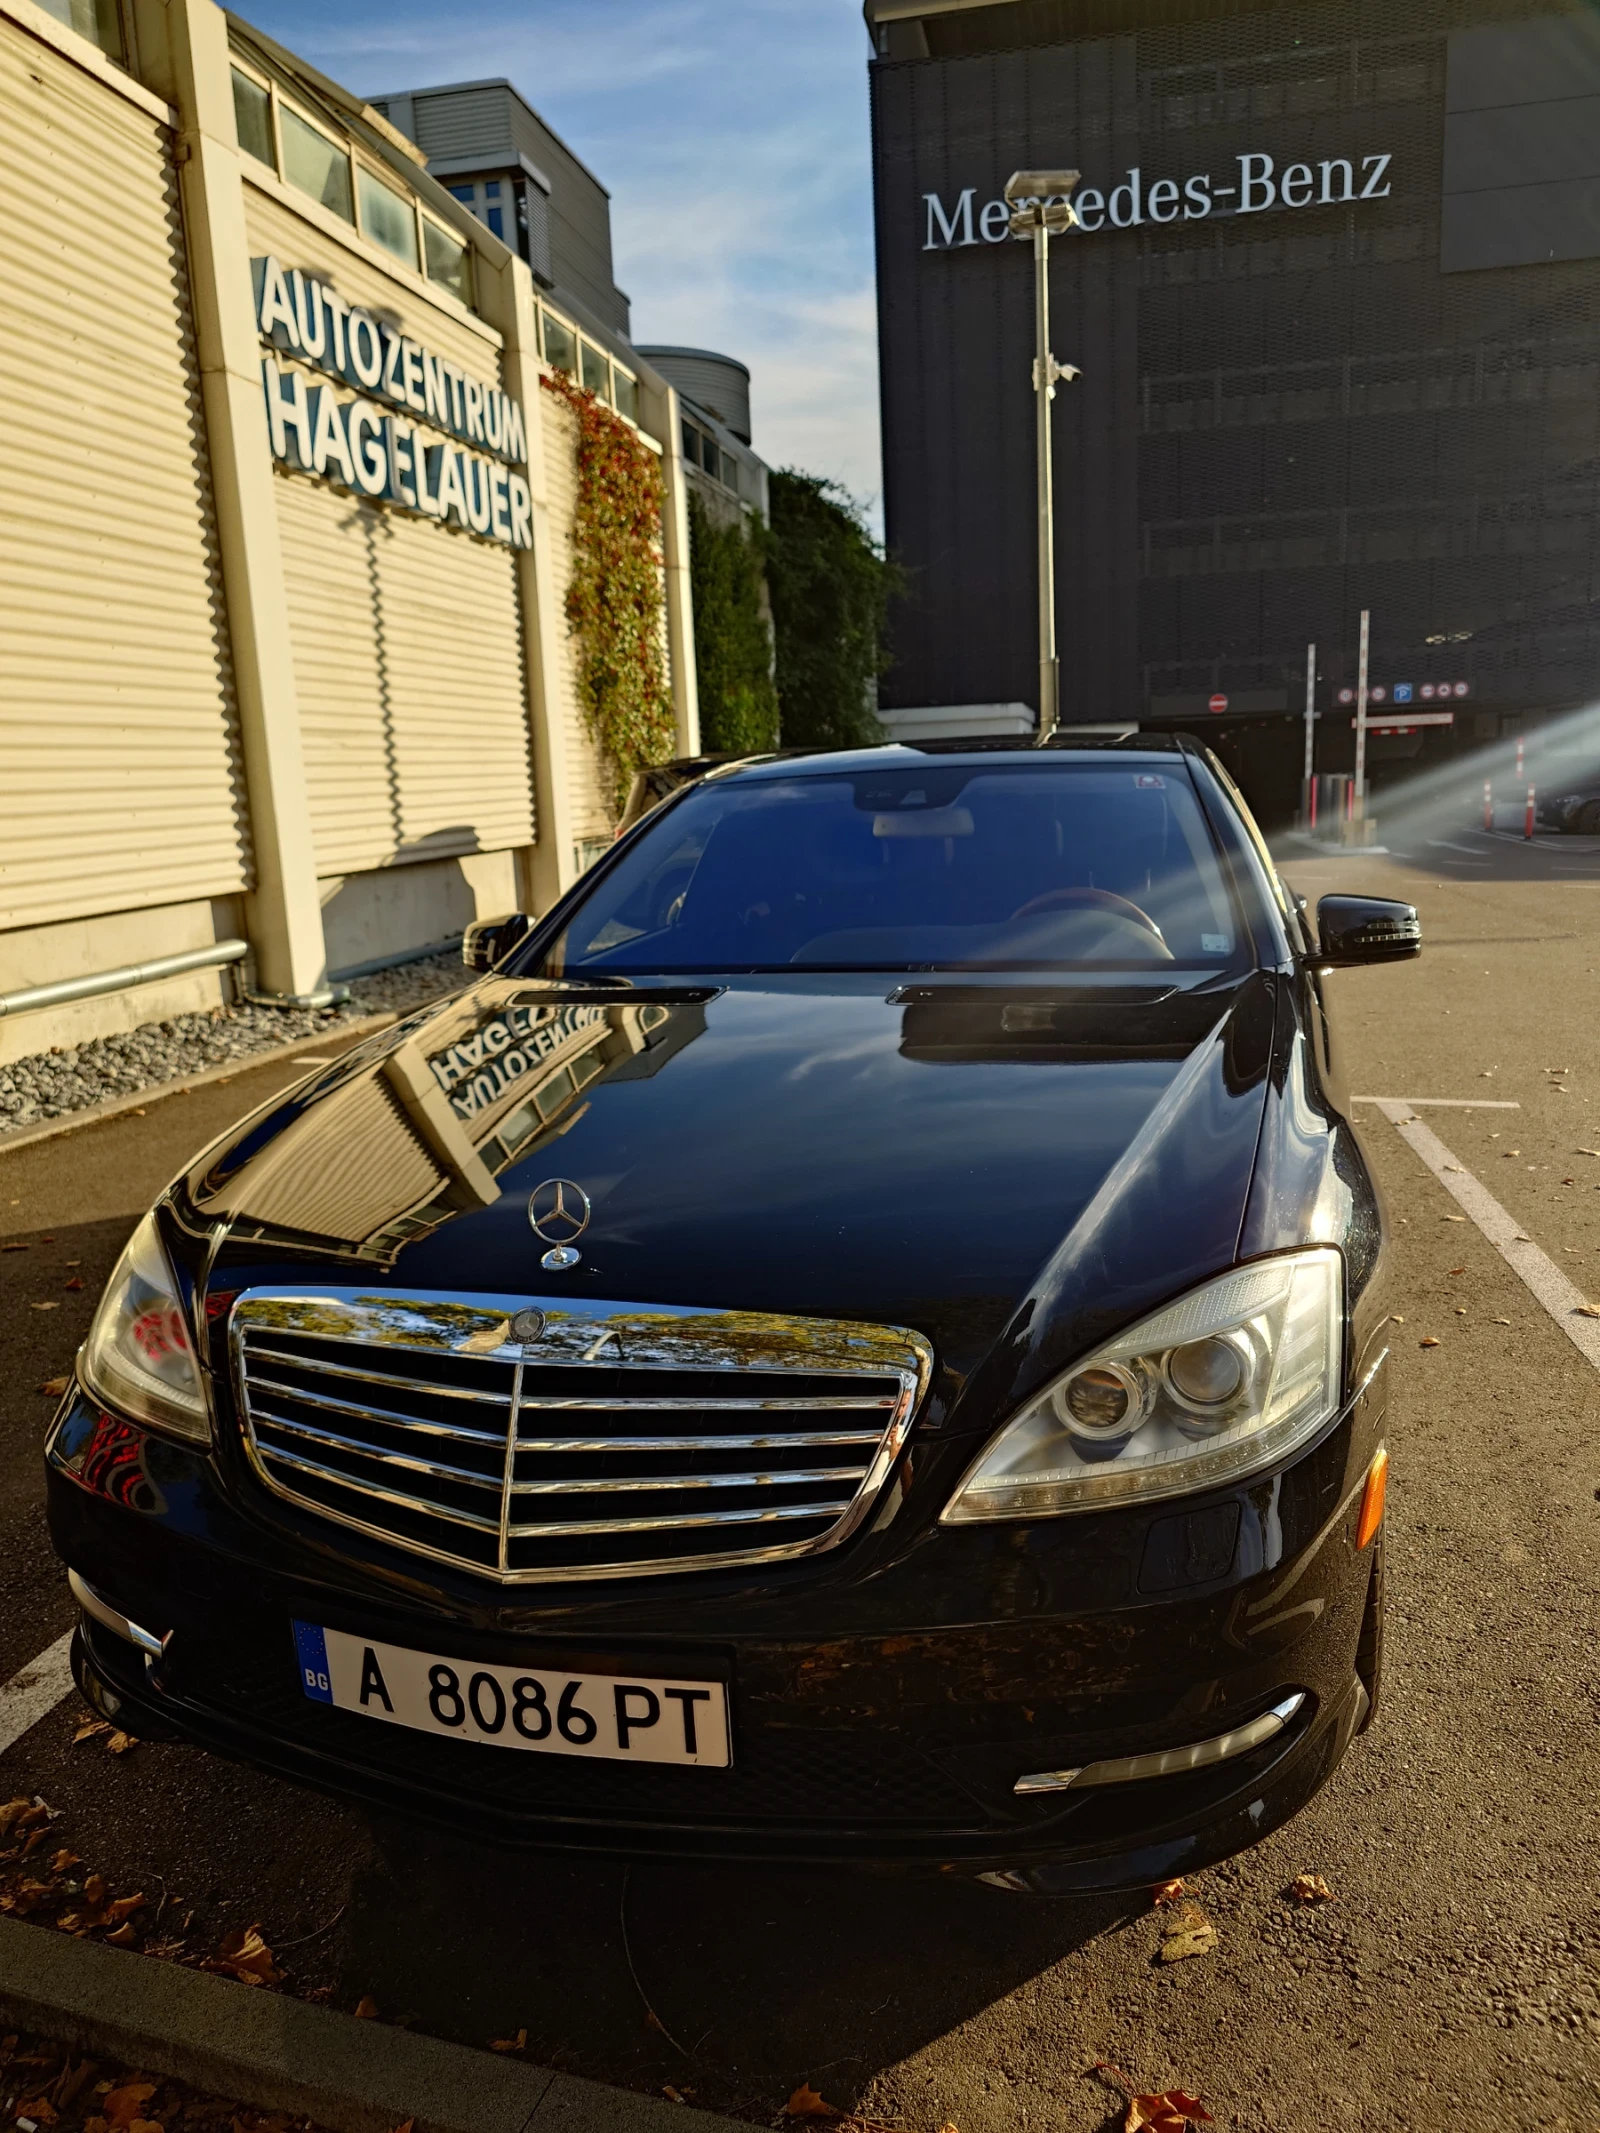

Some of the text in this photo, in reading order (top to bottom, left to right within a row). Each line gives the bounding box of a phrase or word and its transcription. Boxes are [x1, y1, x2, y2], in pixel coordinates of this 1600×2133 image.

[258, 255, 528, 463] AUTOZENTRUM
[264, 358, 533, 549] HAGELAUER
[304, 1668, 328, 1691] BG
[359, 1646, 710, 1754] A 8086 PT
